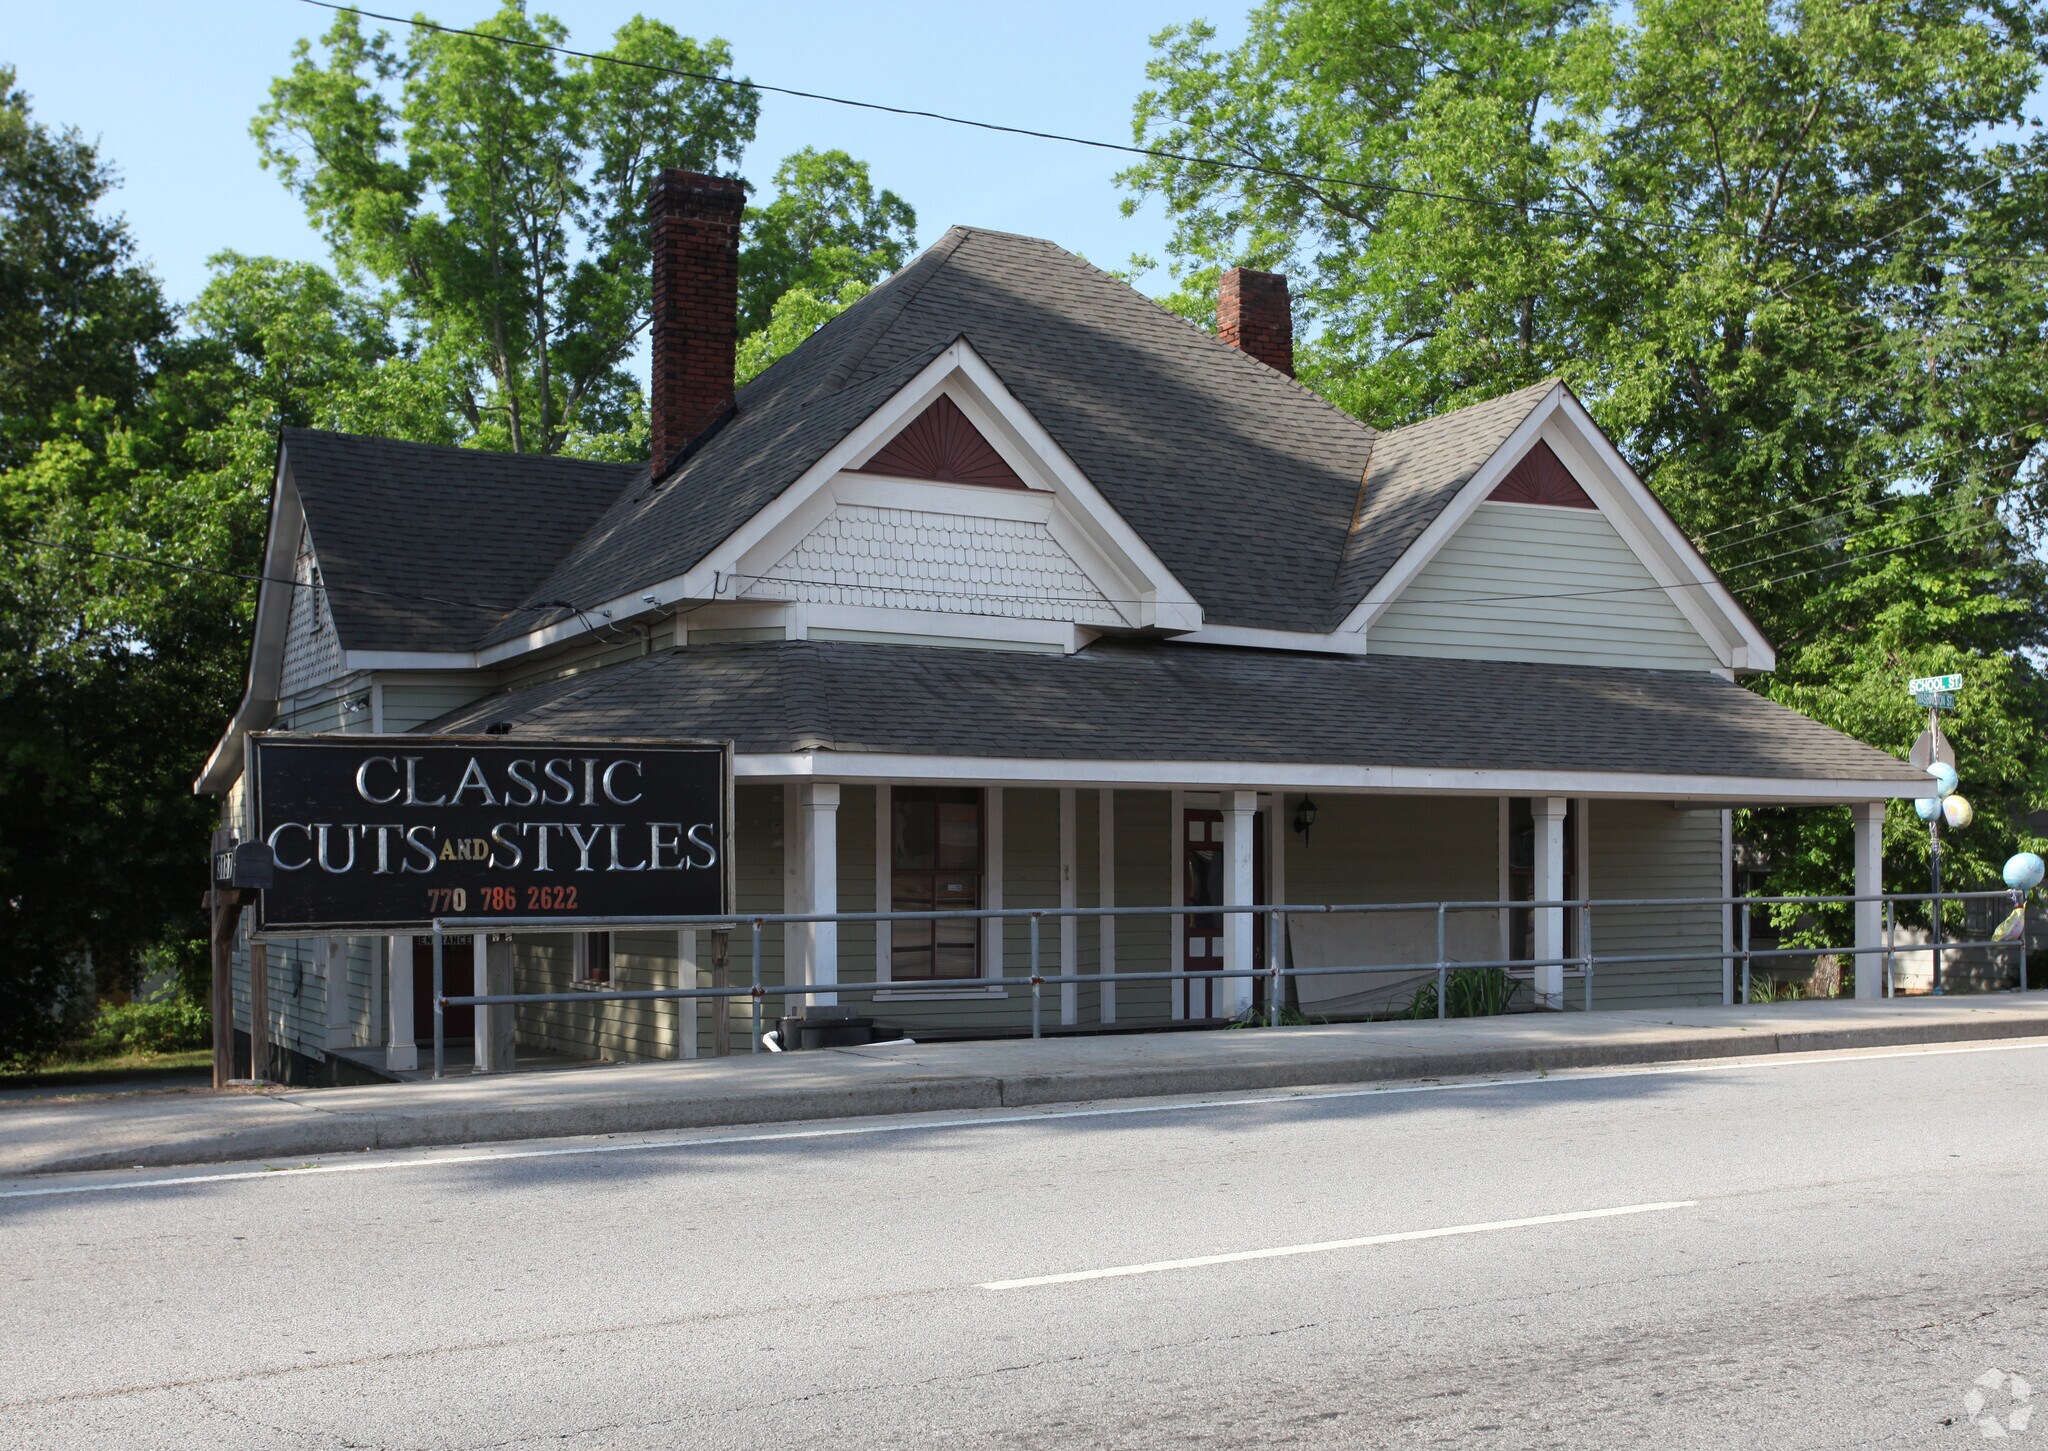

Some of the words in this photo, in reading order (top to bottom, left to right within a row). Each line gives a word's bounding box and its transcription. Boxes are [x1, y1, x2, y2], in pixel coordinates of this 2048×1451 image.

[1910, 677, 1946, 693] SCHOOL
[355, 756, 643, 807] CLASSIC
[267, 822, 439, 875] CUTS
[438, 837, 490, 862] AND
[488, 821, 718, 873] STYLES
[427, 887, 467, 913] 770
[480, 886, 517, 911] 786
[527, 885, 579, 910] 2622
